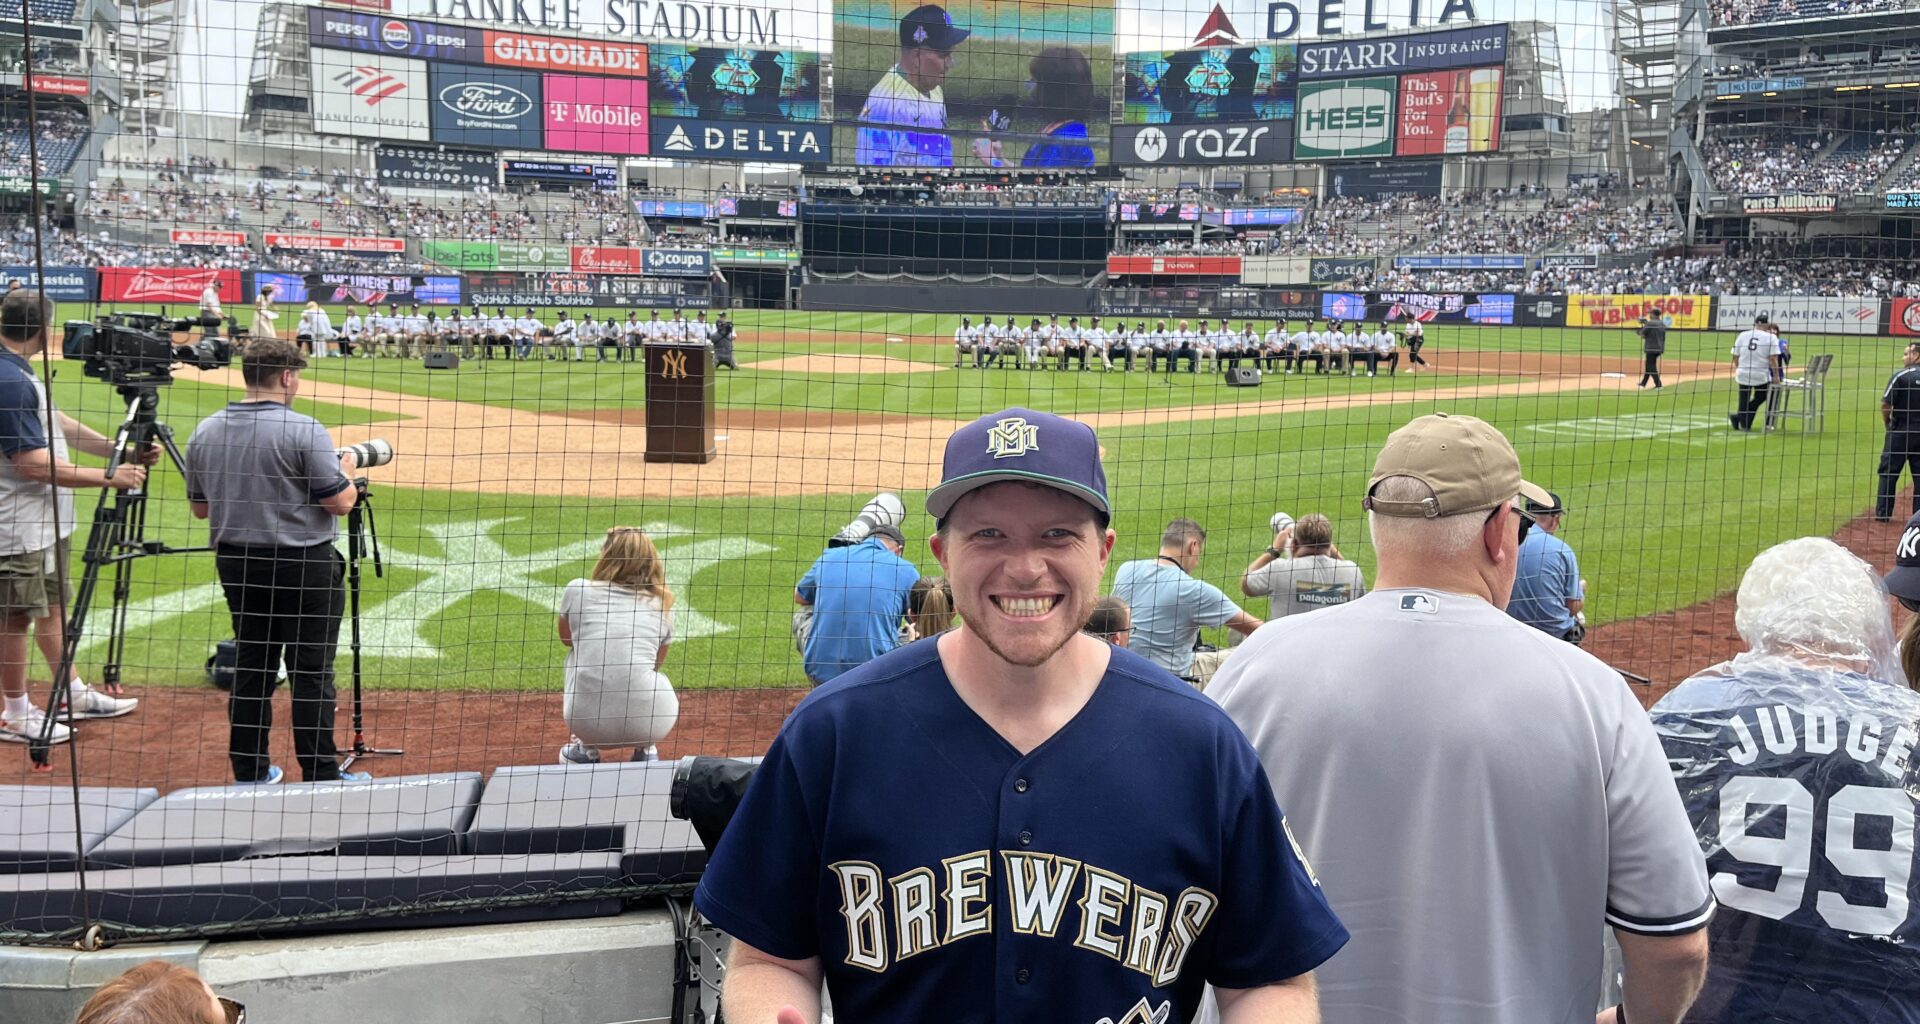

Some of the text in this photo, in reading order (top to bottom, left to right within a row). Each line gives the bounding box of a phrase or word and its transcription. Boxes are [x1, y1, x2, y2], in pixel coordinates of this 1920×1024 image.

[607, 0, 780, 45] STADIUM
[325, 21, 368, 37] PEPSI
[426, 34, 465, 48] PEPSI
[494, 37, 640, 70] GATORADE
[1301, 36, 1502, 73] STARR INSURANCE
[1404, 78, 1438, 91] This
[1751, 81, 1764, 90] CUP
[456, 86, 517, 115] Ford
[1405, 92, 1444, 107] Bud's
[316, 111, 425, 128] BANK OF AMERICA
[550, 102, 642, 127] T Mobile
[1306, 105, 1385, 131] HESS
[1404, 109, 1427, 122] For
[1403, 123, 1434, 136] You.
[704, 127, 820, 153] DELTA
[1178, 126, 1269, 158] razr
[1743, 194, 1836, 209] Parts Authority
[1909, 193, 1920, 201] YO
[462, 250, 495, 263] Eats
[665, 254, 704, 268] coupa
[30, 272, 84, 285] Enstein
[136, 277, 207, 292] Budweiser
[471, 294, 594, 305] StubHub StubHub StubHub
[1624, 298, 1694, 321] MASON
[1720, 308, 1757, 318] BANK
[1780, 310, 1843, 321] AMERICA
[1748, 337, 1760, 351] 6
[1298, 593, 1348, 605] patagonia
[1727, 704, 1918, 780] JUDGE
[184, 792, 236, 800] PADS
[239, 790, 269, 798] ON
[272, 789, 304, 797] SIT
[1709, 775, 1915, 936] 99
[828, 849, 1219, 988] BREWERS
